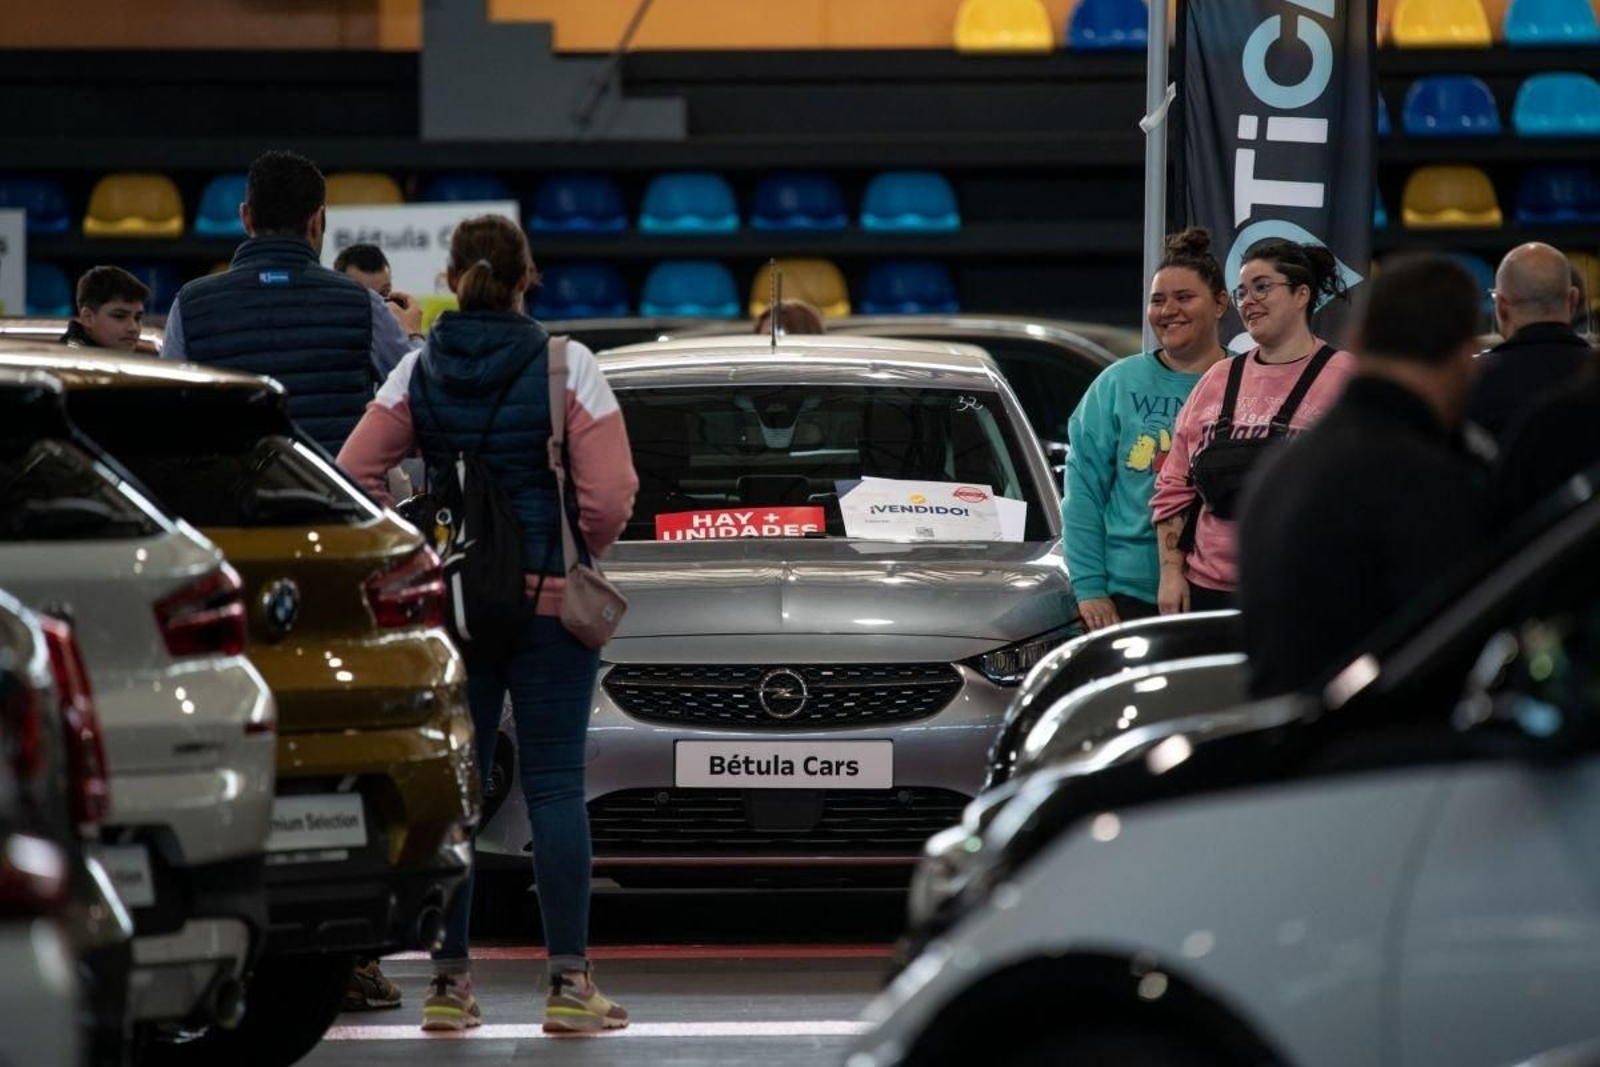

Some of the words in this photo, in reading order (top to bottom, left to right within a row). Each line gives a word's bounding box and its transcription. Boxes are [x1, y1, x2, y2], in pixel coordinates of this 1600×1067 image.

[869, 504, 971, 517] ¡VENDIDO!
[692, 512, 754, 528] HAY
[763, 513, 779, 523] +
[663, 524, 818, 541] UNIDADES
[709, 754, 795, 776] Bétula
[803, 756, 859, 776] Cars
[304, 812, 359, 831] Selection
